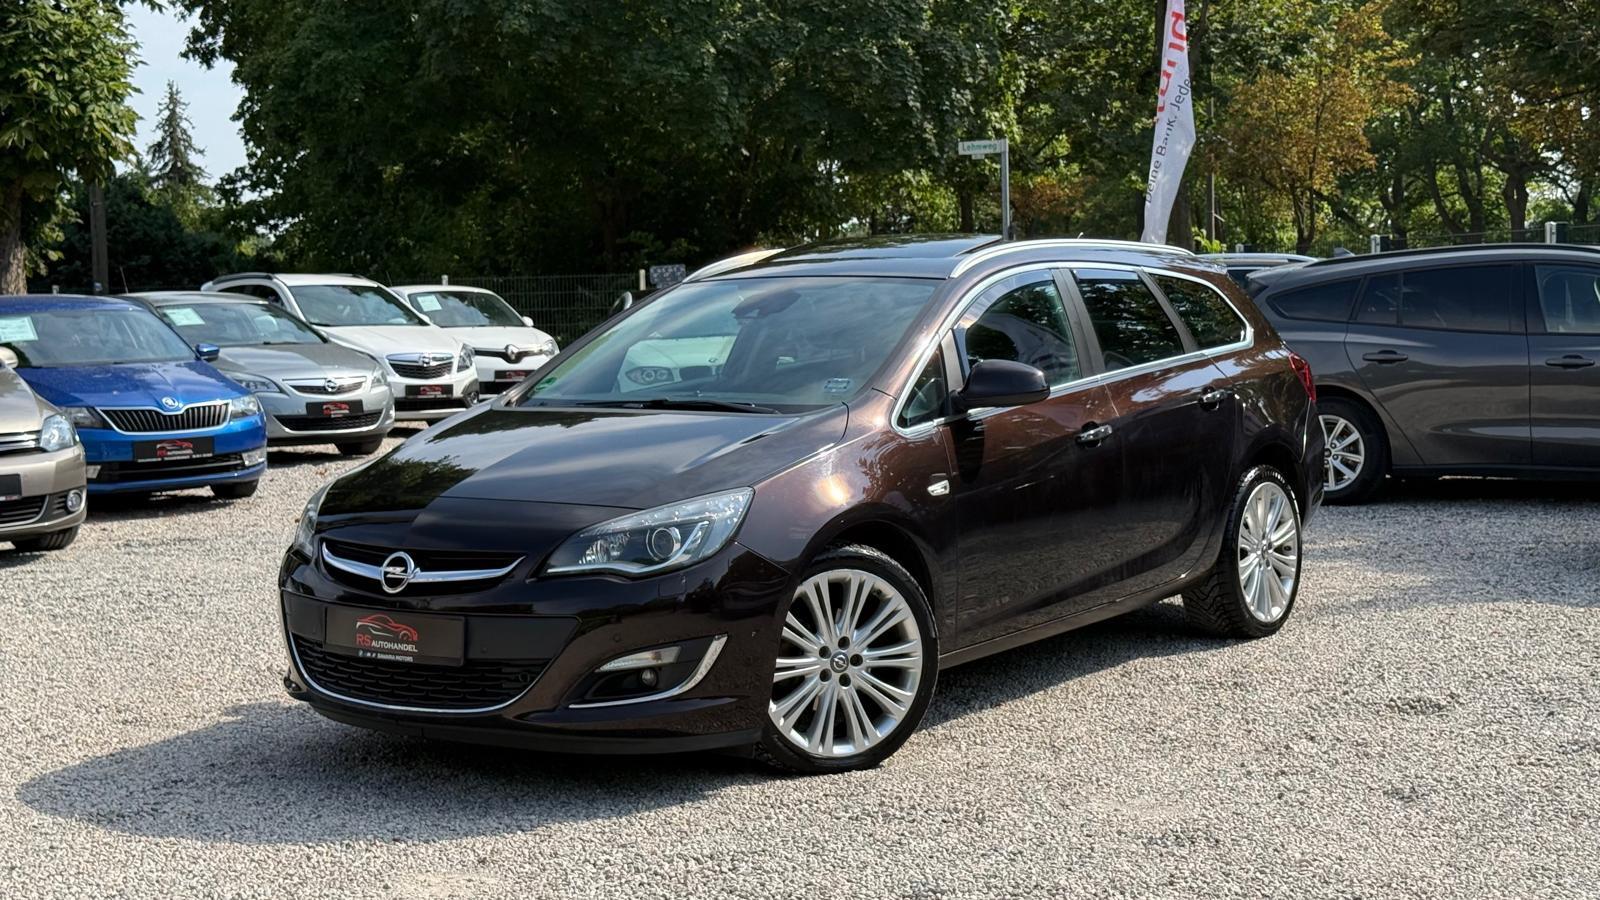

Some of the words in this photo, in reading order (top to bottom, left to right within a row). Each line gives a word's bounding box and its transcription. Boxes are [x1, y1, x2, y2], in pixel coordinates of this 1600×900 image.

[962, 142, 998, 152] Lehmweg
[1145, 160, 1162, 204] Deine
[356, 634, 371, 647] RS
[371, 639, 419, 653] AUTOHANDEL
